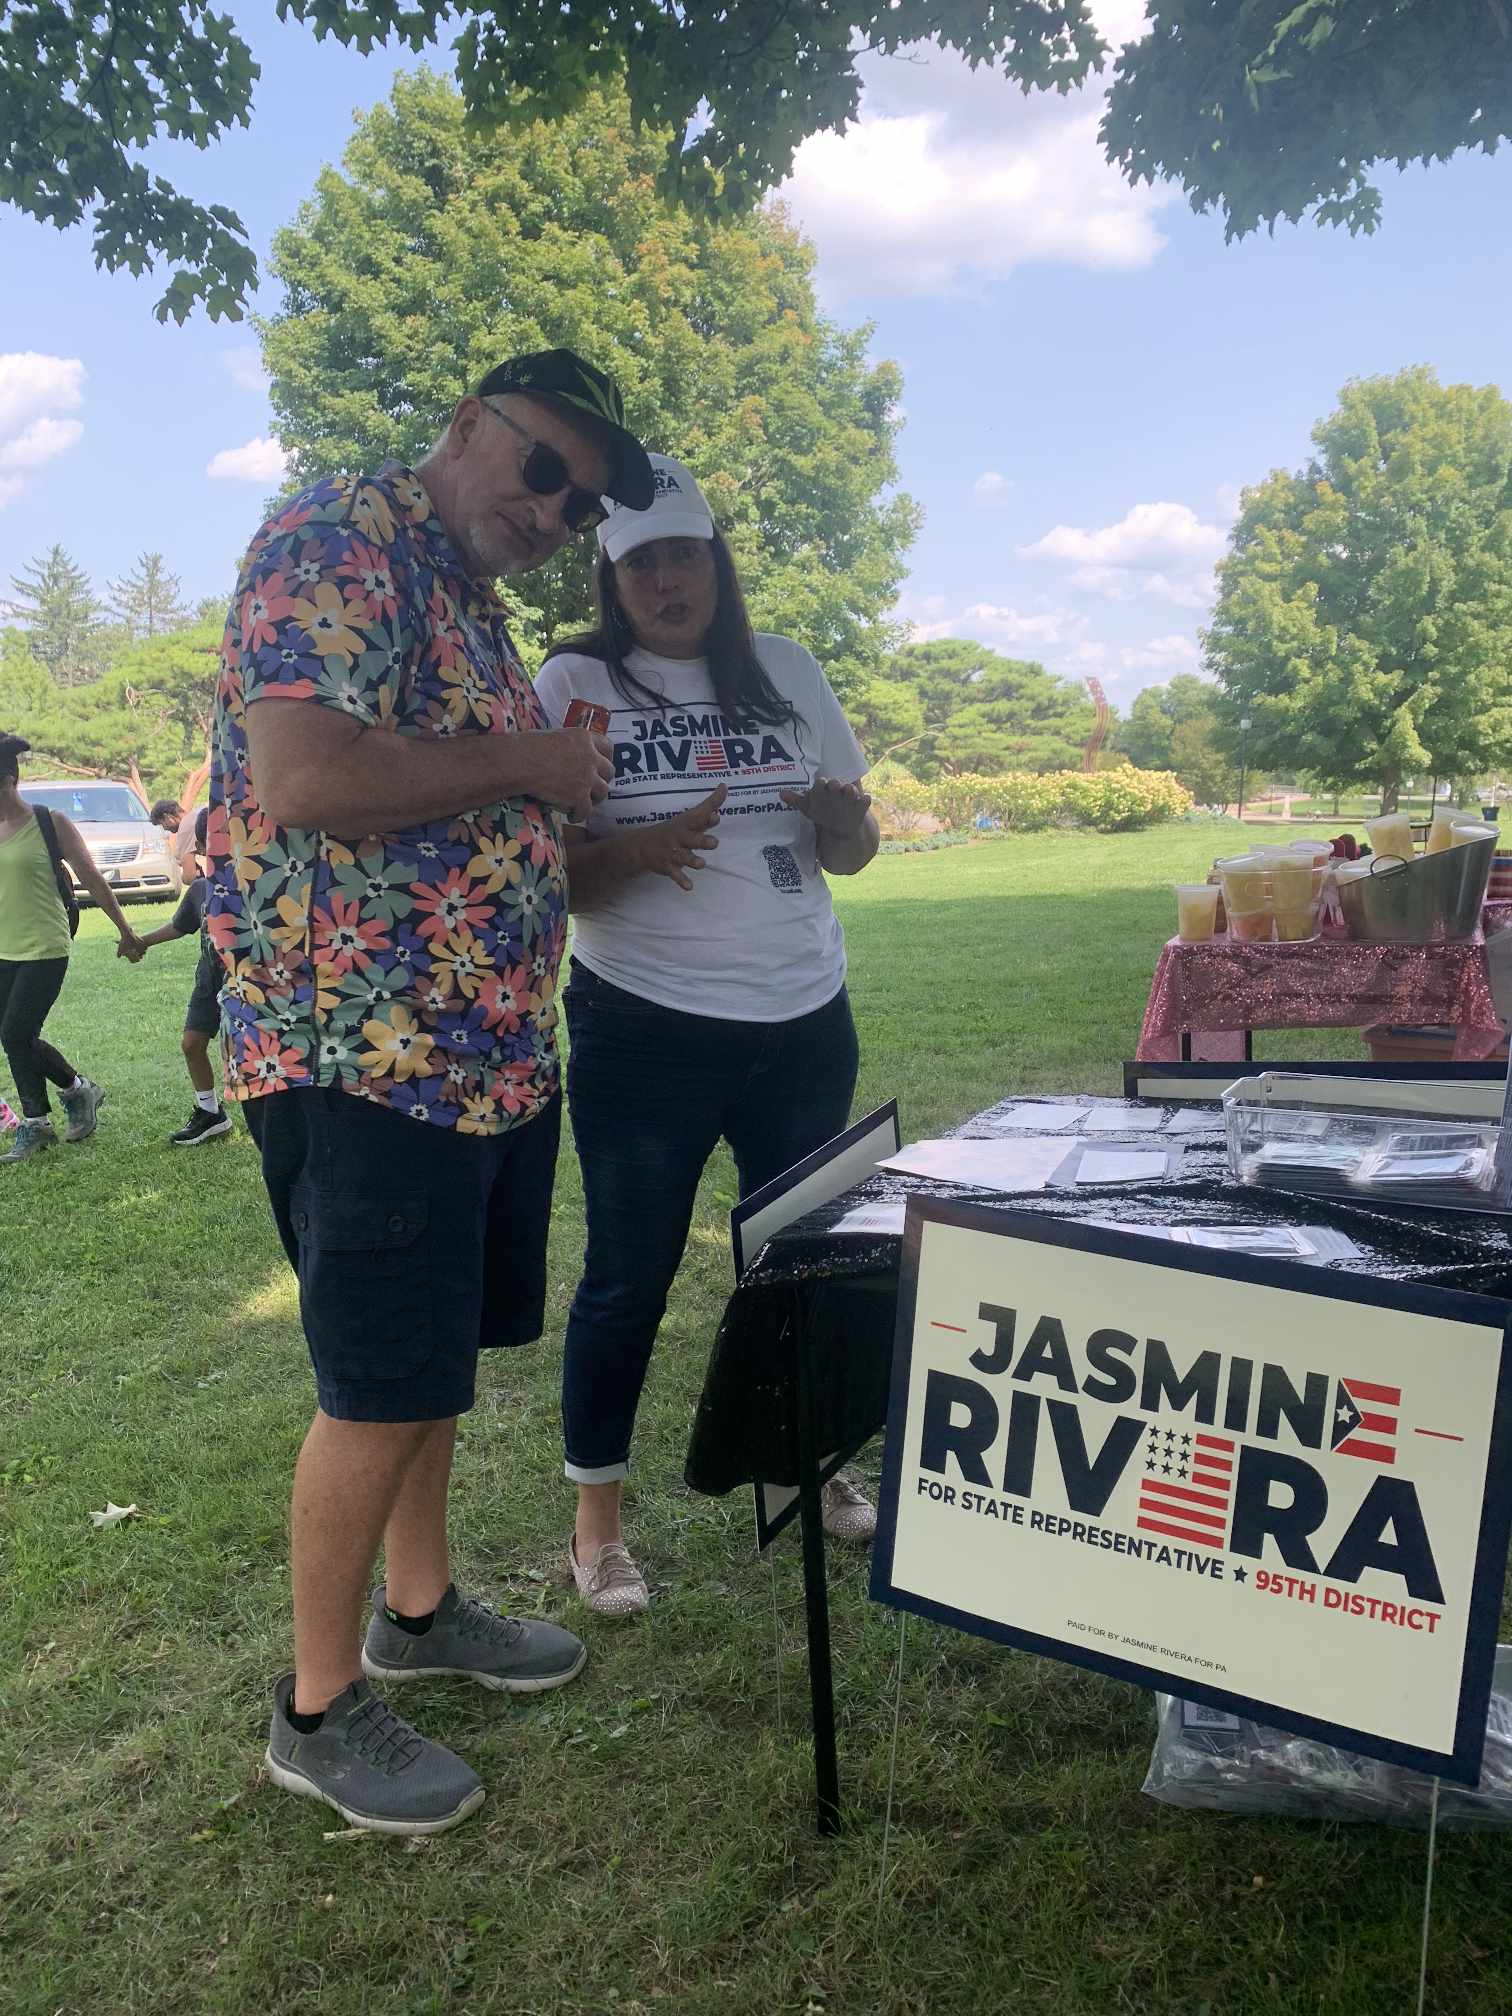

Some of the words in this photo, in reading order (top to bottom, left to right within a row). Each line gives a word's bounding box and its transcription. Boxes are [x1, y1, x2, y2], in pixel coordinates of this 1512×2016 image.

[632, 713, 760, 741] JASMINE
[613, 735, 795, 778] RIVERA
[615, 778, 631, 787] FOR
[633, 774, 658, 784] STATE
[660, 770, 733, 780] REPRESENTATIVE
[764, 763, 797, 773] DISTRICT
[969, 1302, 1401, 1465] JASMINE
[919, 1368, 1446, 1606] RIVERA
[917, 1477, 956, 1506] FOR
[961, 1491, 1025, 1526] STATE
[1030, 1510, 1225, 1580] REPRESENTATIVE
[1255, 1570, 1317, 1603] 95TH
[1323, 1587, 1442, 1634] DISTRICT
[1066, 1619, 1087, 1632] PAID
[1088, 1625, 1106, 1637] FOR
[1107, 1631, 1120, 1640] BY
[1120, 1635, 1158, 1653] JASMINE
[1160, 1647, 1193, 1664] RIVERA
[1194, 1657, 1214, 1670] FOR
[1215, 1663, 1228, 1673] PA
